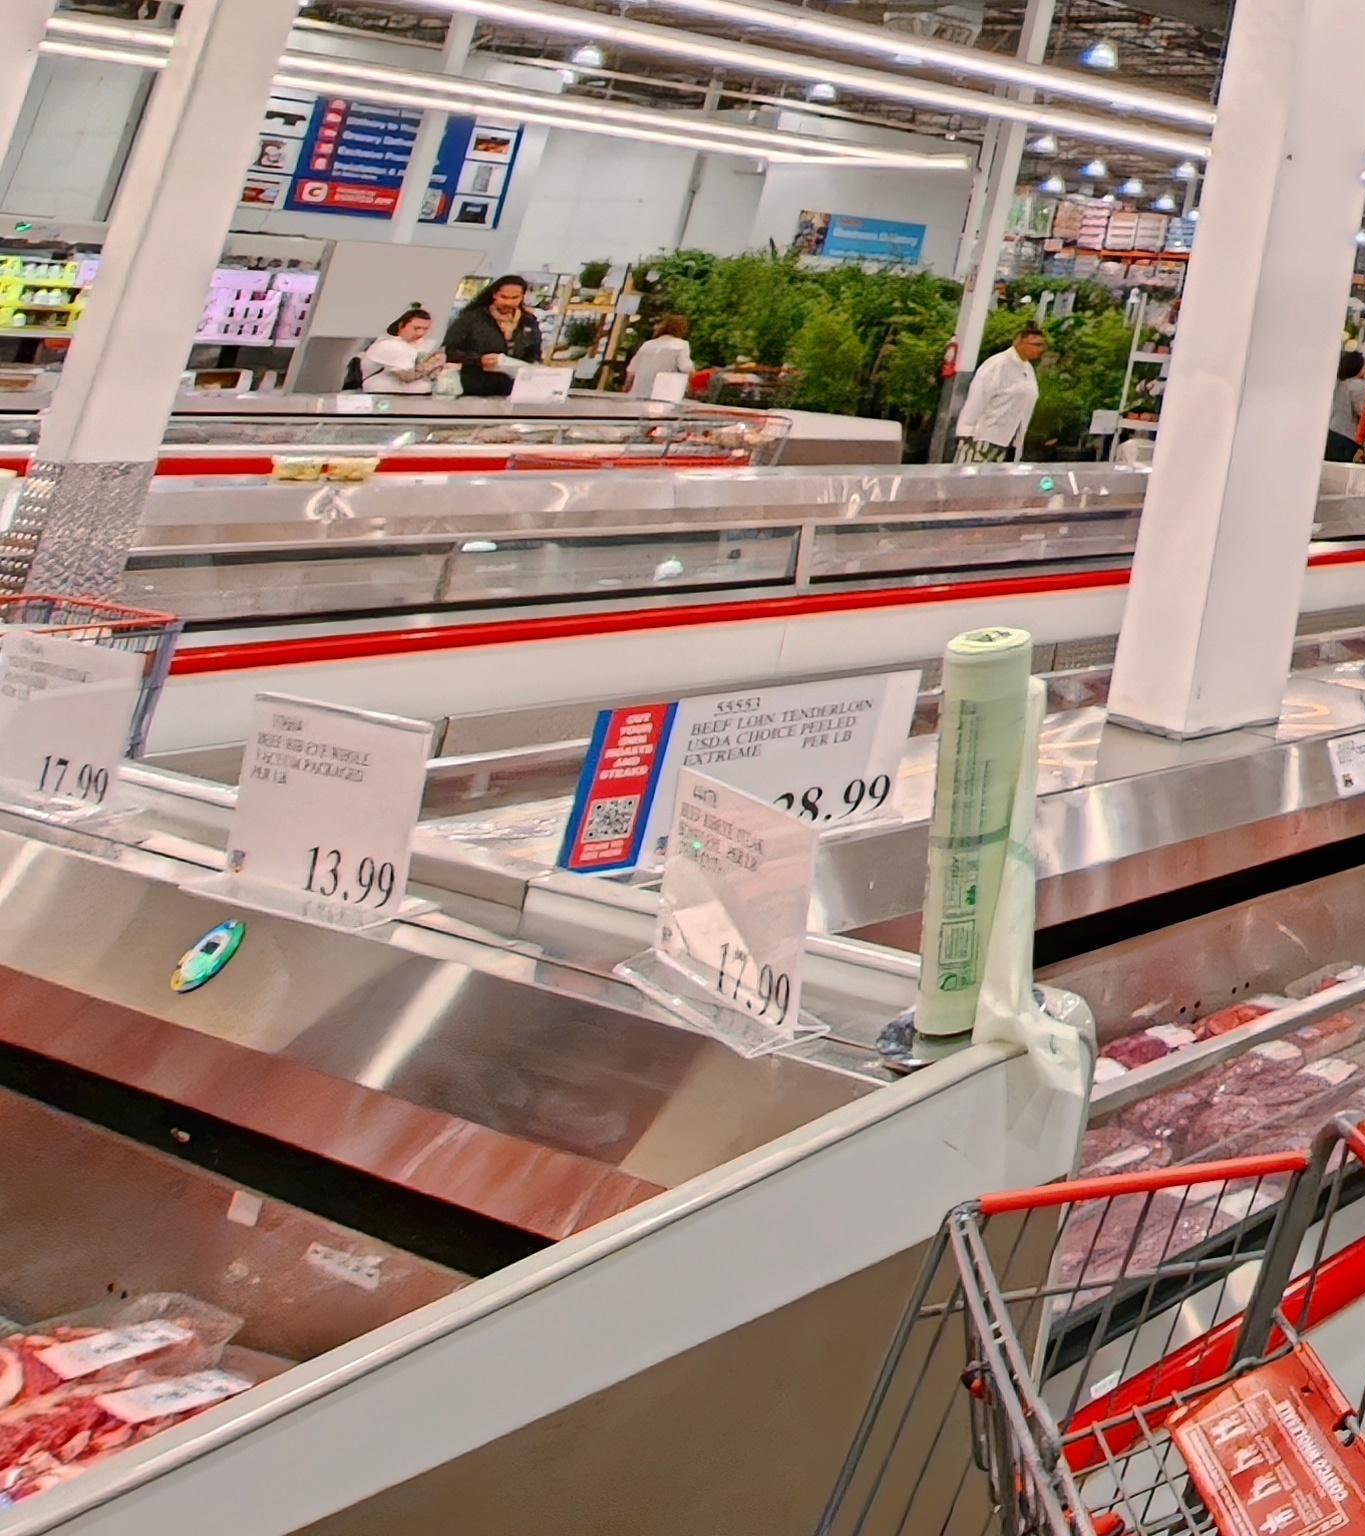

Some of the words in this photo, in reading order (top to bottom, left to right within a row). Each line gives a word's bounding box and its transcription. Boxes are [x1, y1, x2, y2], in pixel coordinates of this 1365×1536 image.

[686, 735, 734, 752] USDA
[735, 724, 798, 745] CHOICE
[800, 715, 857, 736] PEELED
[690, 718, 733, 736] BEEF
[736, 712, 777, 730] LOIN
[781, 698, 873, 723] TENDERLOIN
[682, 744, 763, 766] EXTREME
[801, 735, 829, 749] PER
[833, 730, 853, 744] LB
[35, 754, 109, 805] 17.99
[304, 846, 395, 909] 13.99
[718, 941, 790, 1026] 17.99
